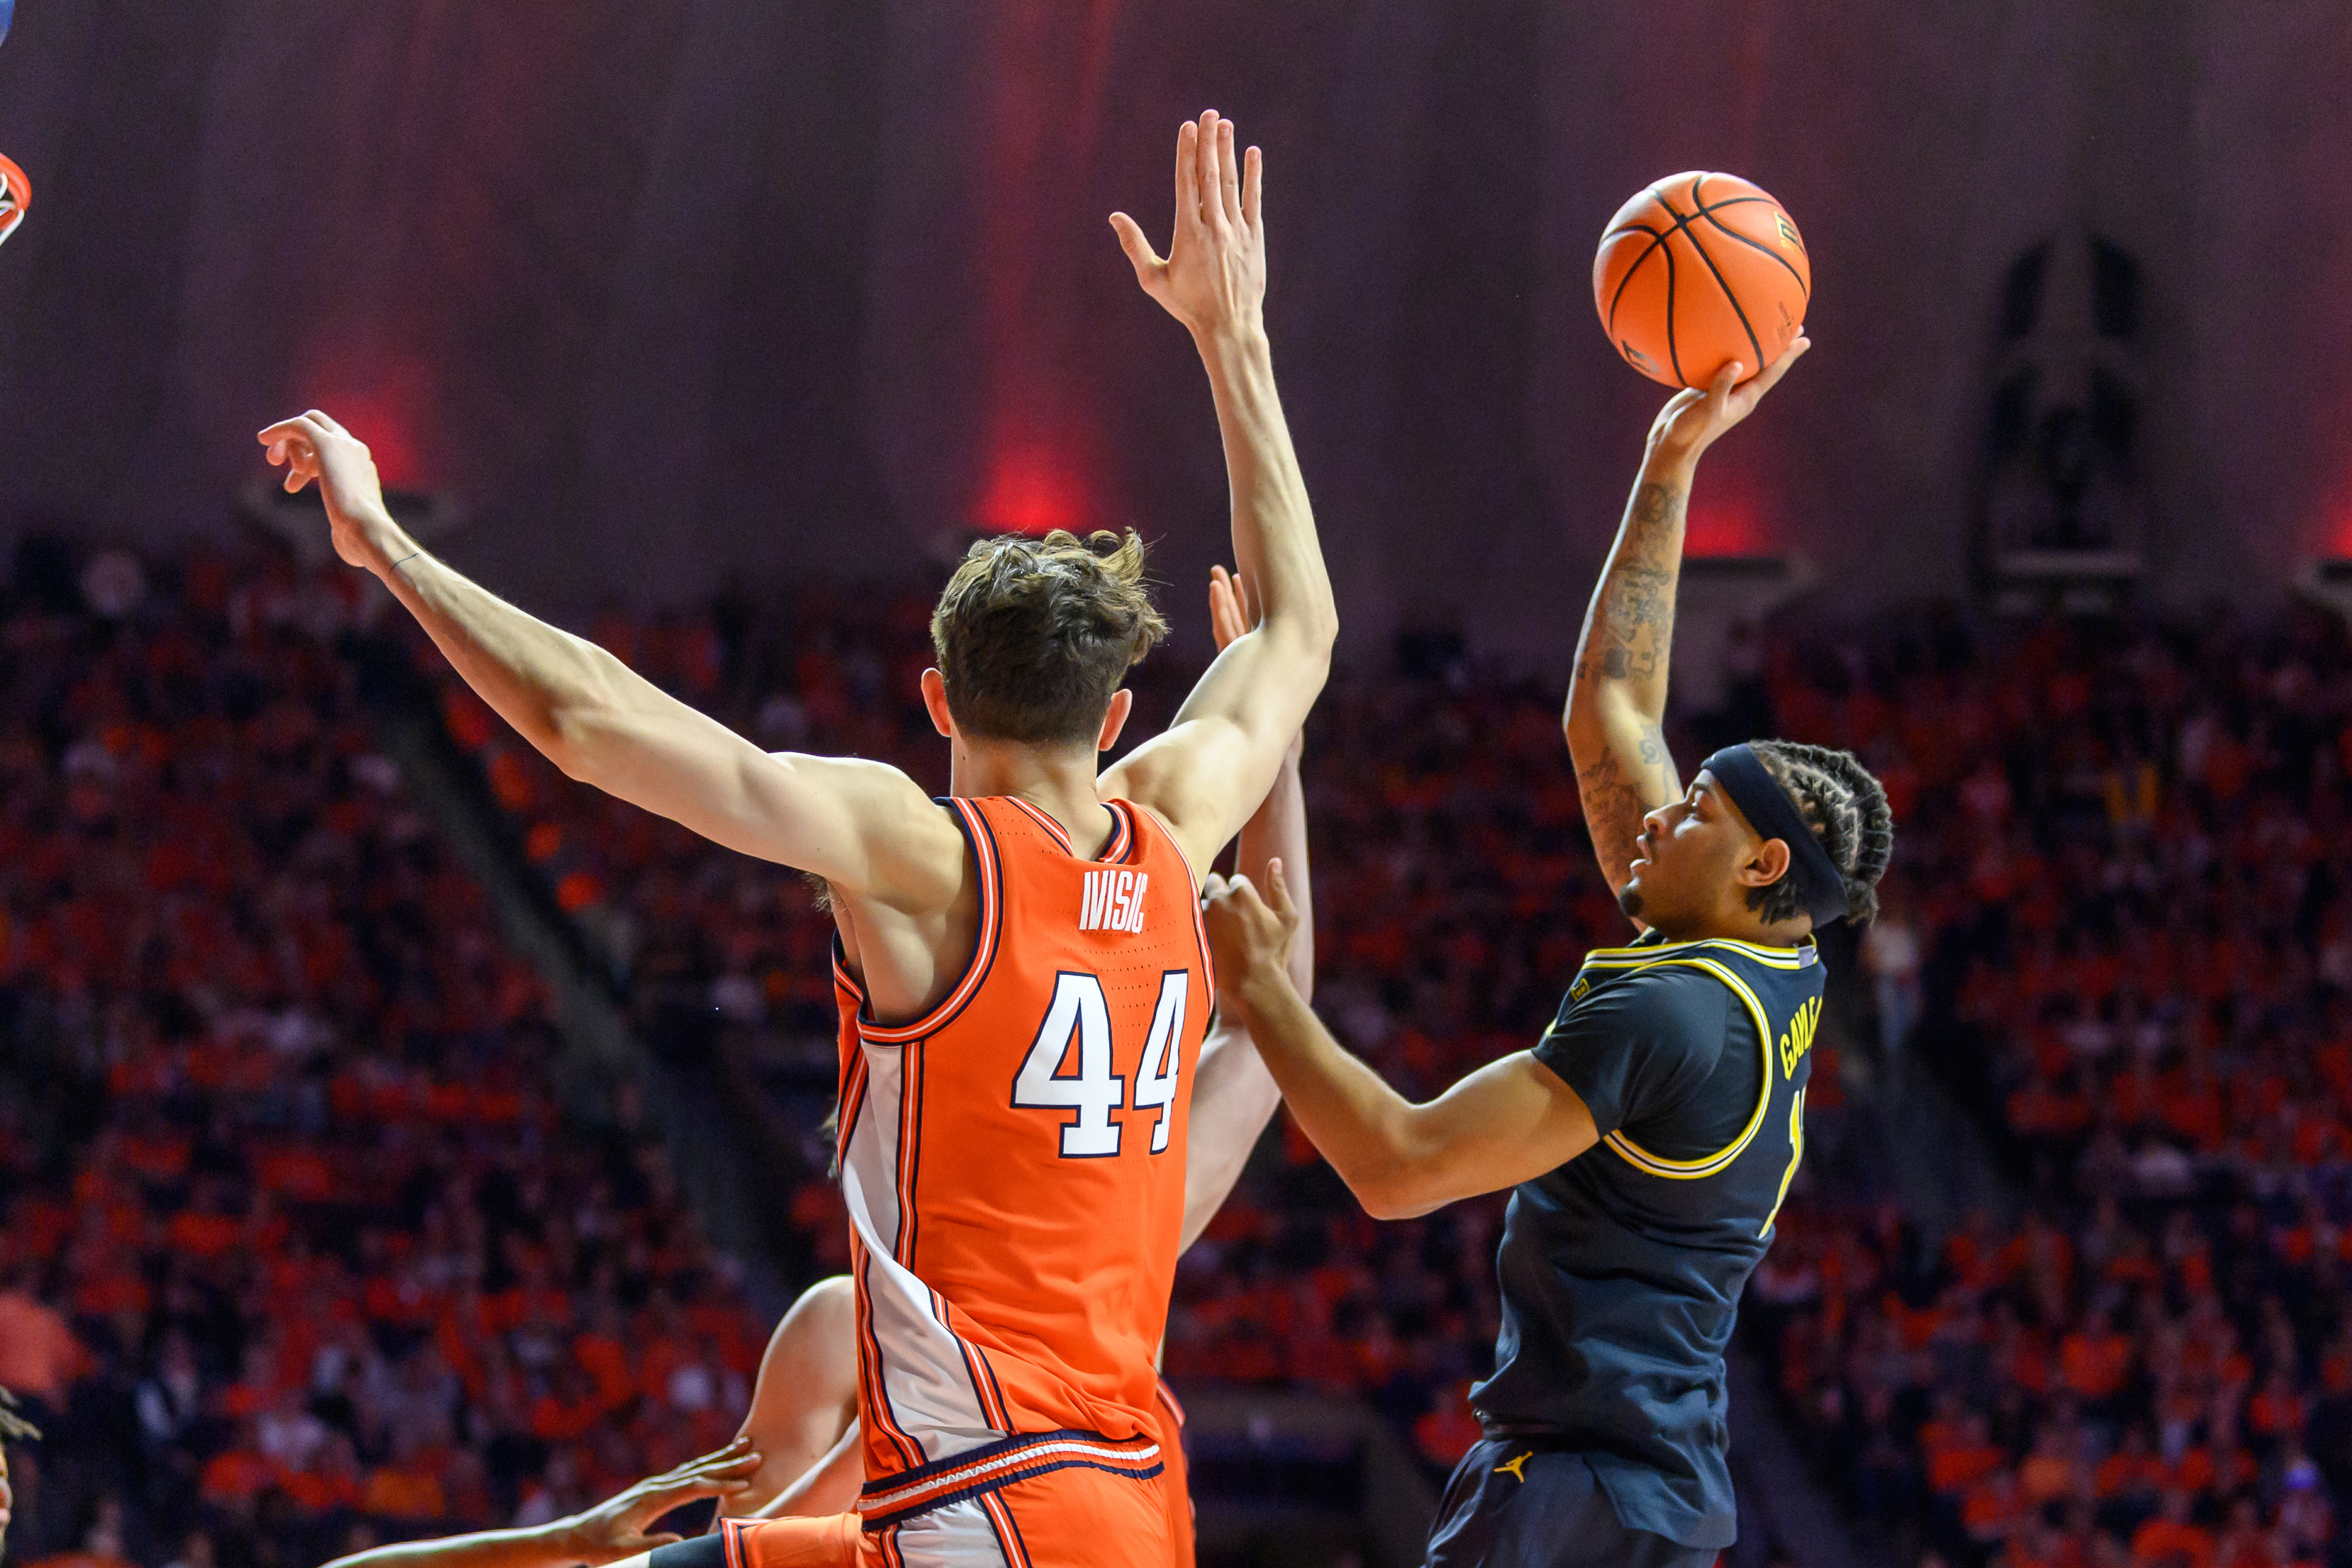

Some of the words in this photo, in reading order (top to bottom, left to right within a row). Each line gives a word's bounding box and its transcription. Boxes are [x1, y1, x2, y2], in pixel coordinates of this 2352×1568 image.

[1079, 870, 1148, 934] IVISIC
[1010, 970, 1188, 1159] 44
[1758, 1086, 1806, 1239] 1
